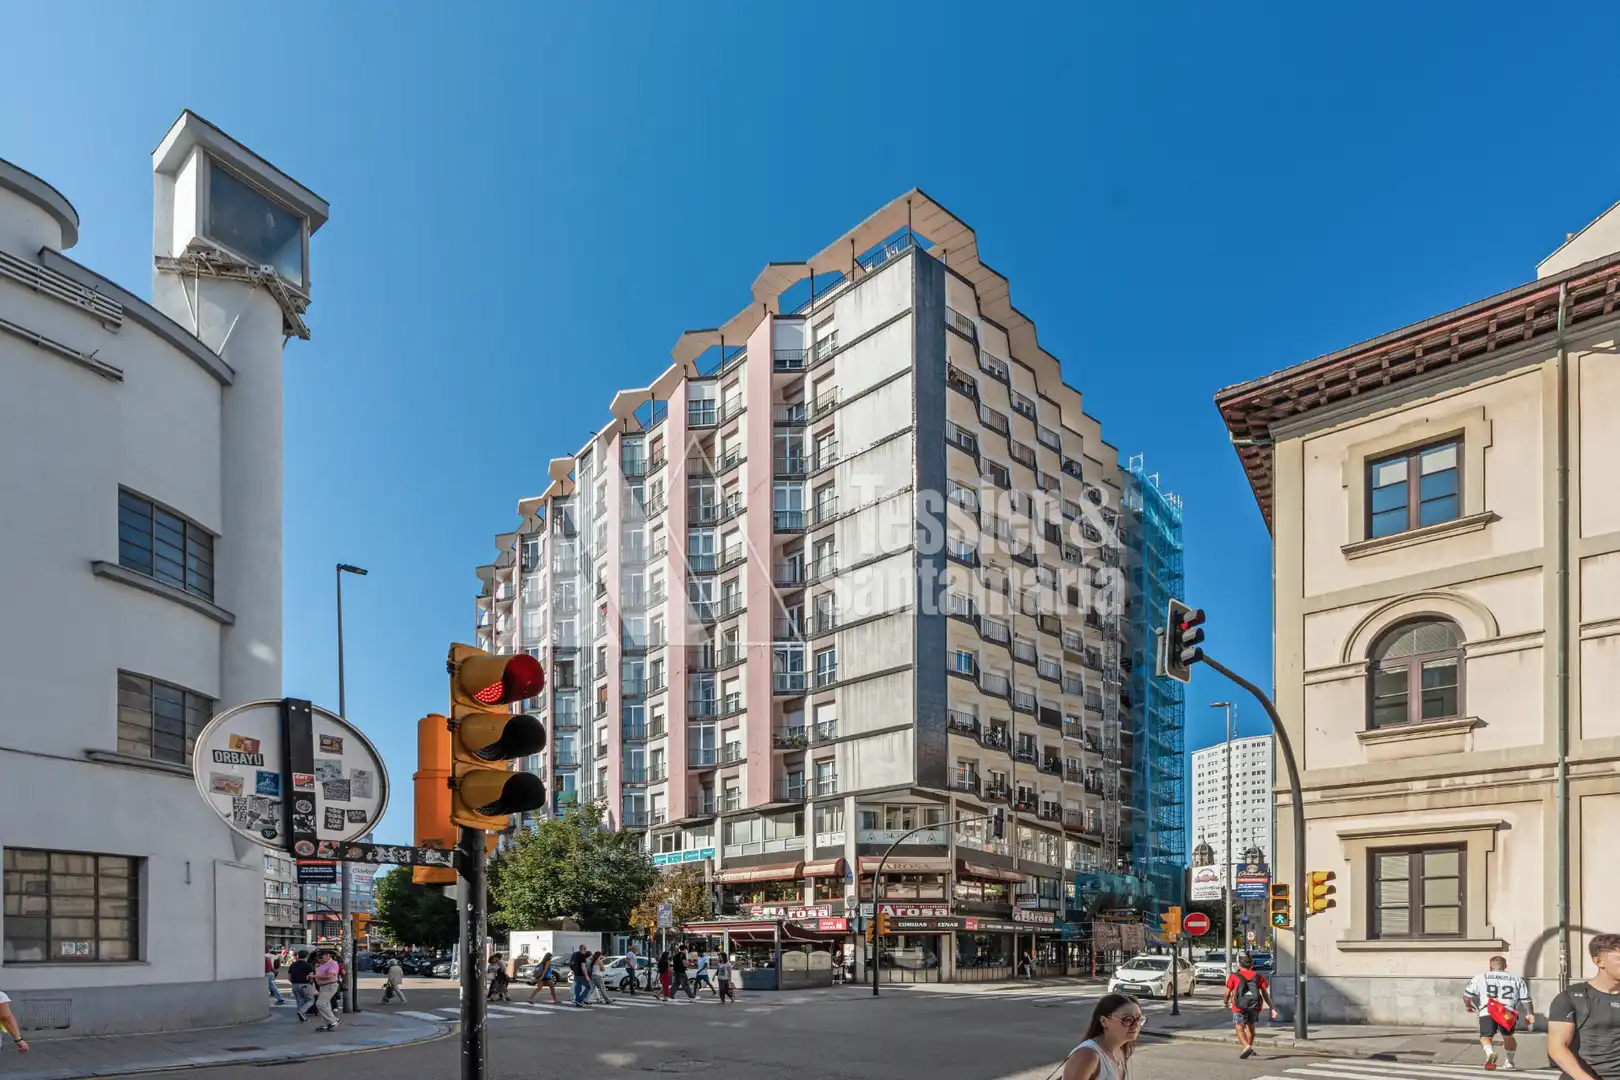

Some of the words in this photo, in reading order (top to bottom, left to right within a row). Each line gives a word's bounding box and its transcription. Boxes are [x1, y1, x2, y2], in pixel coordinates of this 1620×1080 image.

[214, 750, 262, 766] ORBAYU
[881, 905, 947, 917] Arosa
[1029, 912, 1053, 923] Arosa
[1486, 984, 1514, 1000] 92
